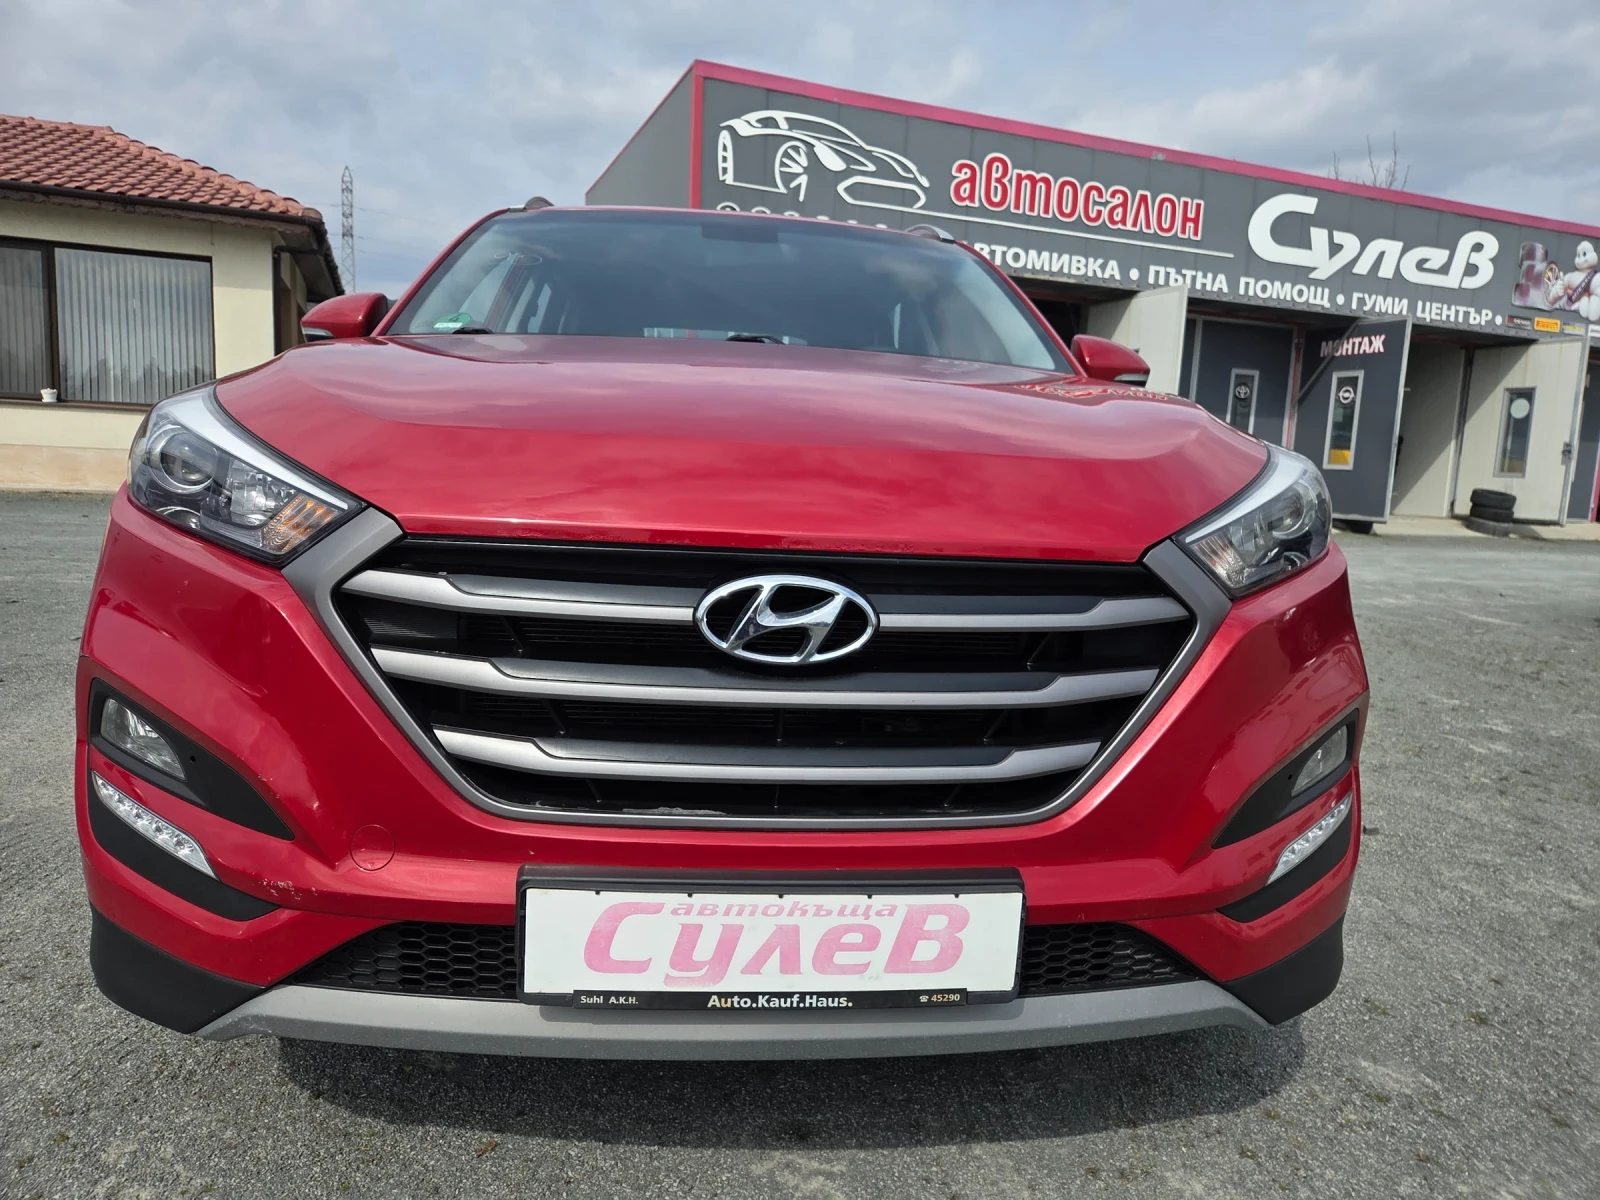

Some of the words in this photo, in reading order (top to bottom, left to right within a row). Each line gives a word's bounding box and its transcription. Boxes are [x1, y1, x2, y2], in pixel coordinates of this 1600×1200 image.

[950, 152, 1205, 241] автосалон
[965, 242, 1121, 280] ВТОМИВКА
[1148, 264, 1228, 293] ПЪТНА
[1238, 276, 1330, 309] ПОМОЩ
[1351, 292, 1408, 316] ГУМИ
[1416, 300, 1492, 326] ЦЕНТЪР
[1320, 334, 1386, 357] МОНТАЖ
[670, 901, 897, 919] автокъща
[580, 995, 603, 1004] Suhl
[608, 996, 639, 1005] A.K.H.
[707, 994, 853, 1008] Auto.Kauf.Haus.
[931, 993, 961, 1002] 45290
